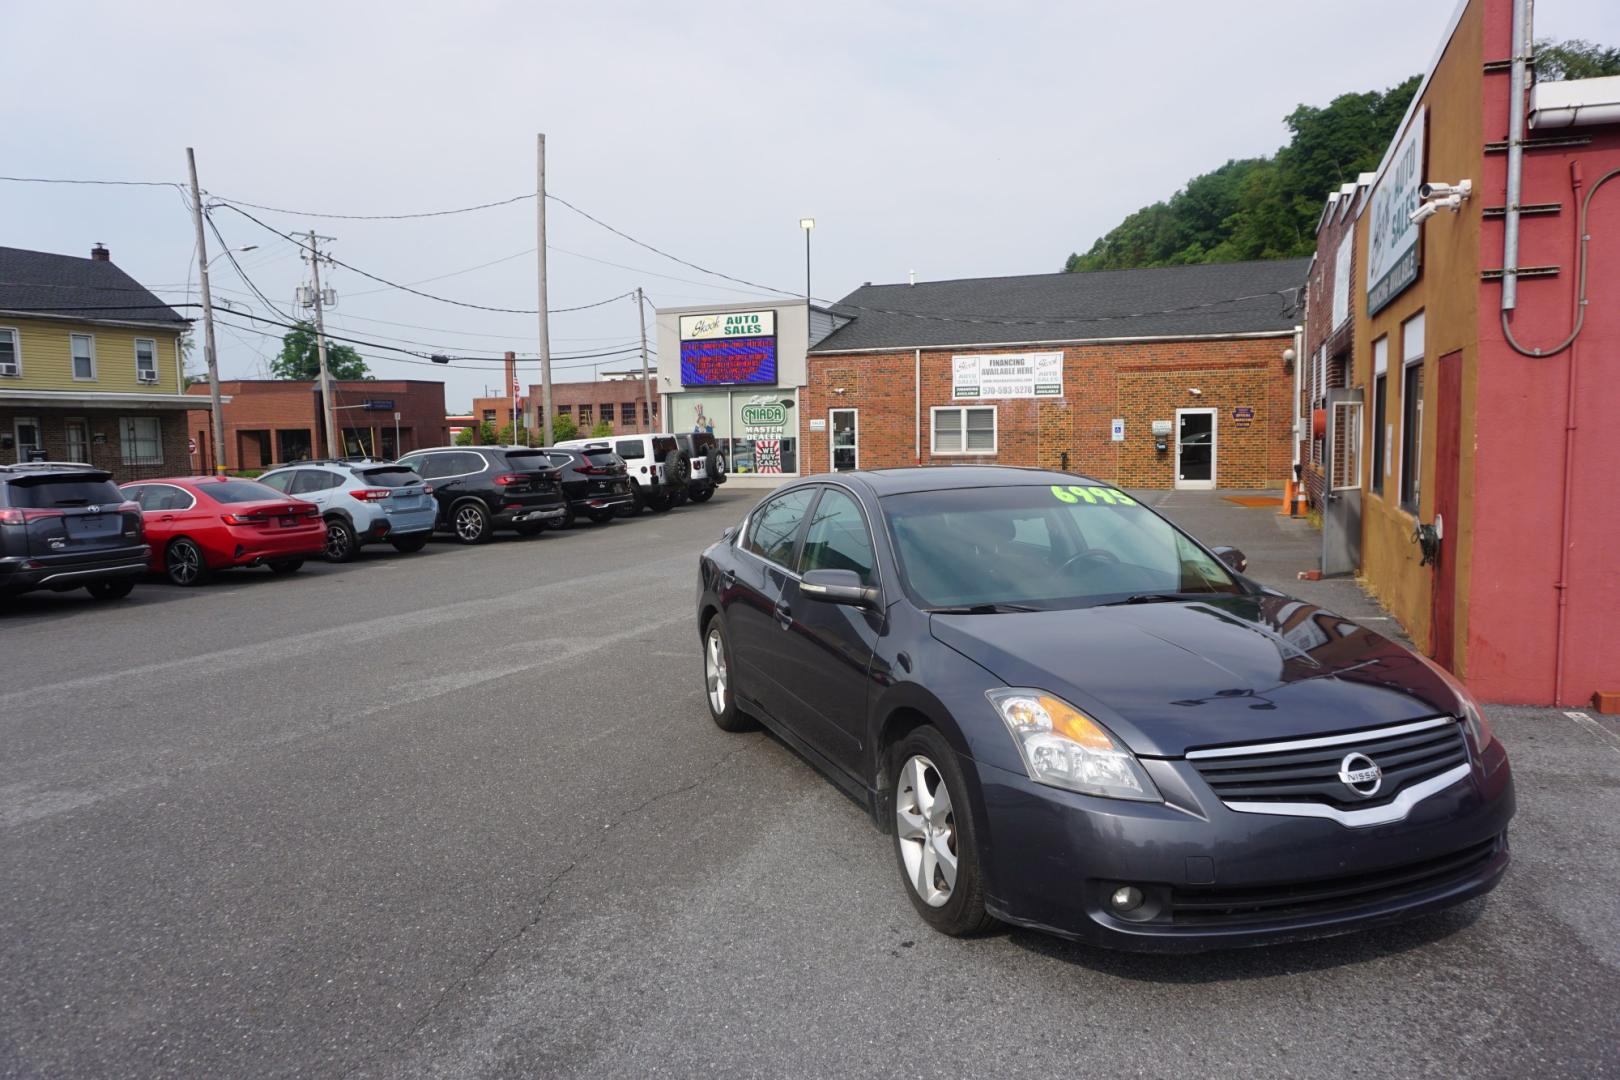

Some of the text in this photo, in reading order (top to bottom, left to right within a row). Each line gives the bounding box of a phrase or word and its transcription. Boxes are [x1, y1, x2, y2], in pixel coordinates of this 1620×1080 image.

[1393, 137, 1416, 203] AUTO
[1391, 185, 1416, 249] SALES
[726, 315, 759, 325] AUTO
[724, 325, 762, 335] SALES
[989, 358, 1025, 366] FINANCING
[744, 408, 782, 422] NIADA
[759, 460, 778, 468] CARS
[1050, 485, 1137, 507] 6995
[1347, 769, 1380, 781] NISSA
